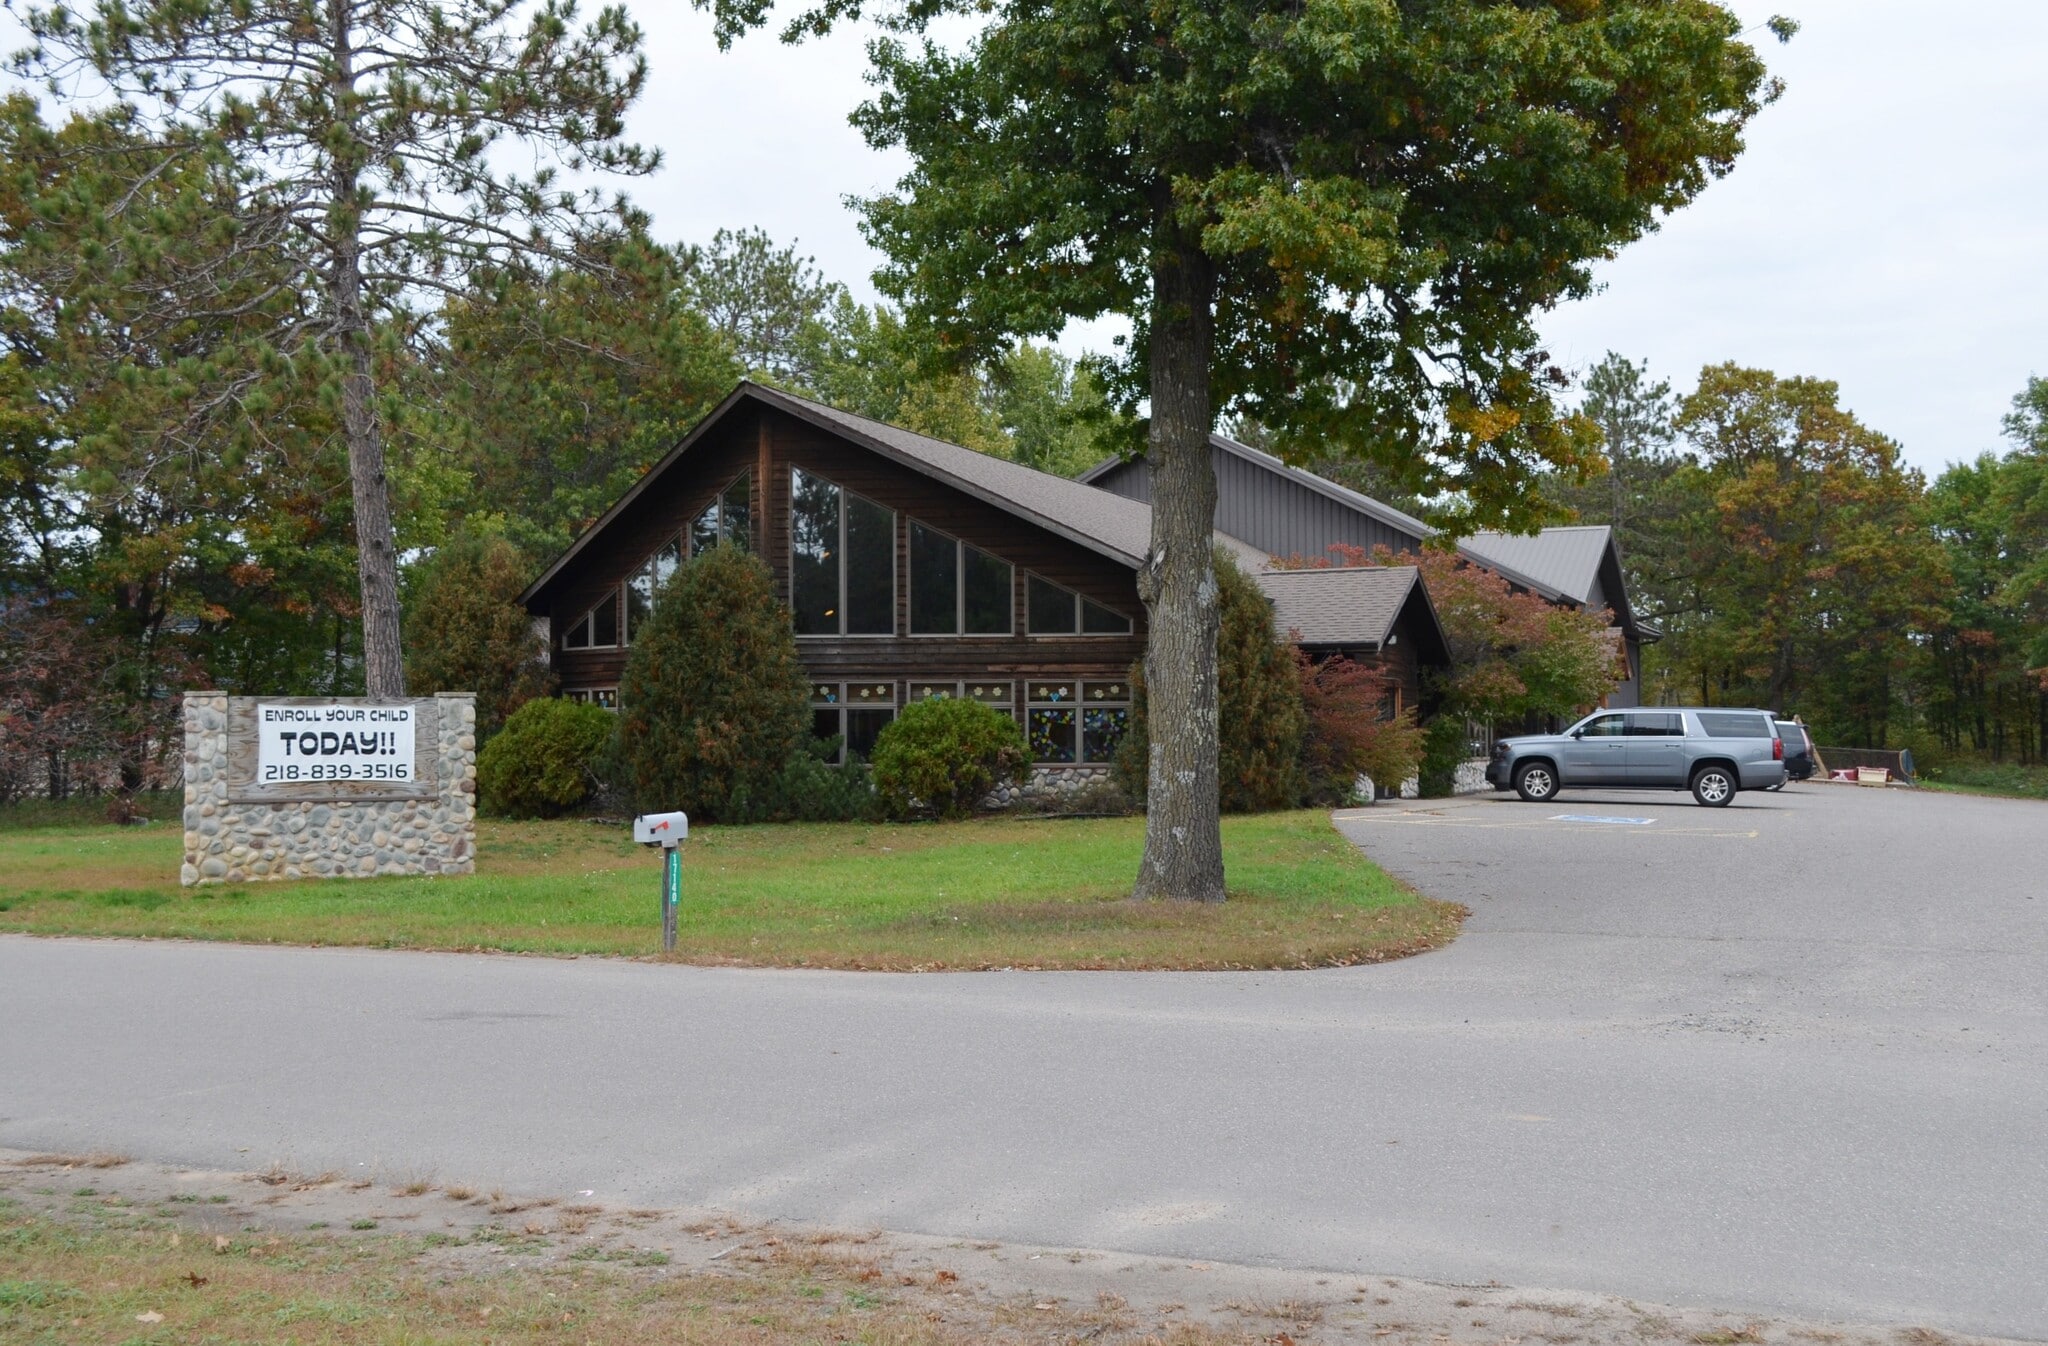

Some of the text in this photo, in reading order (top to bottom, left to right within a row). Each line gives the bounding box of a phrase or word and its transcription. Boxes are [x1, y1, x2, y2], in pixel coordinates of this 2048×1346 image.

[265, 709, 409, 722] ENROLL YOUR CHILD
[280, 731, 396, 756] TODAY!!
[265, 764, 408, 780] 218-839-3516
